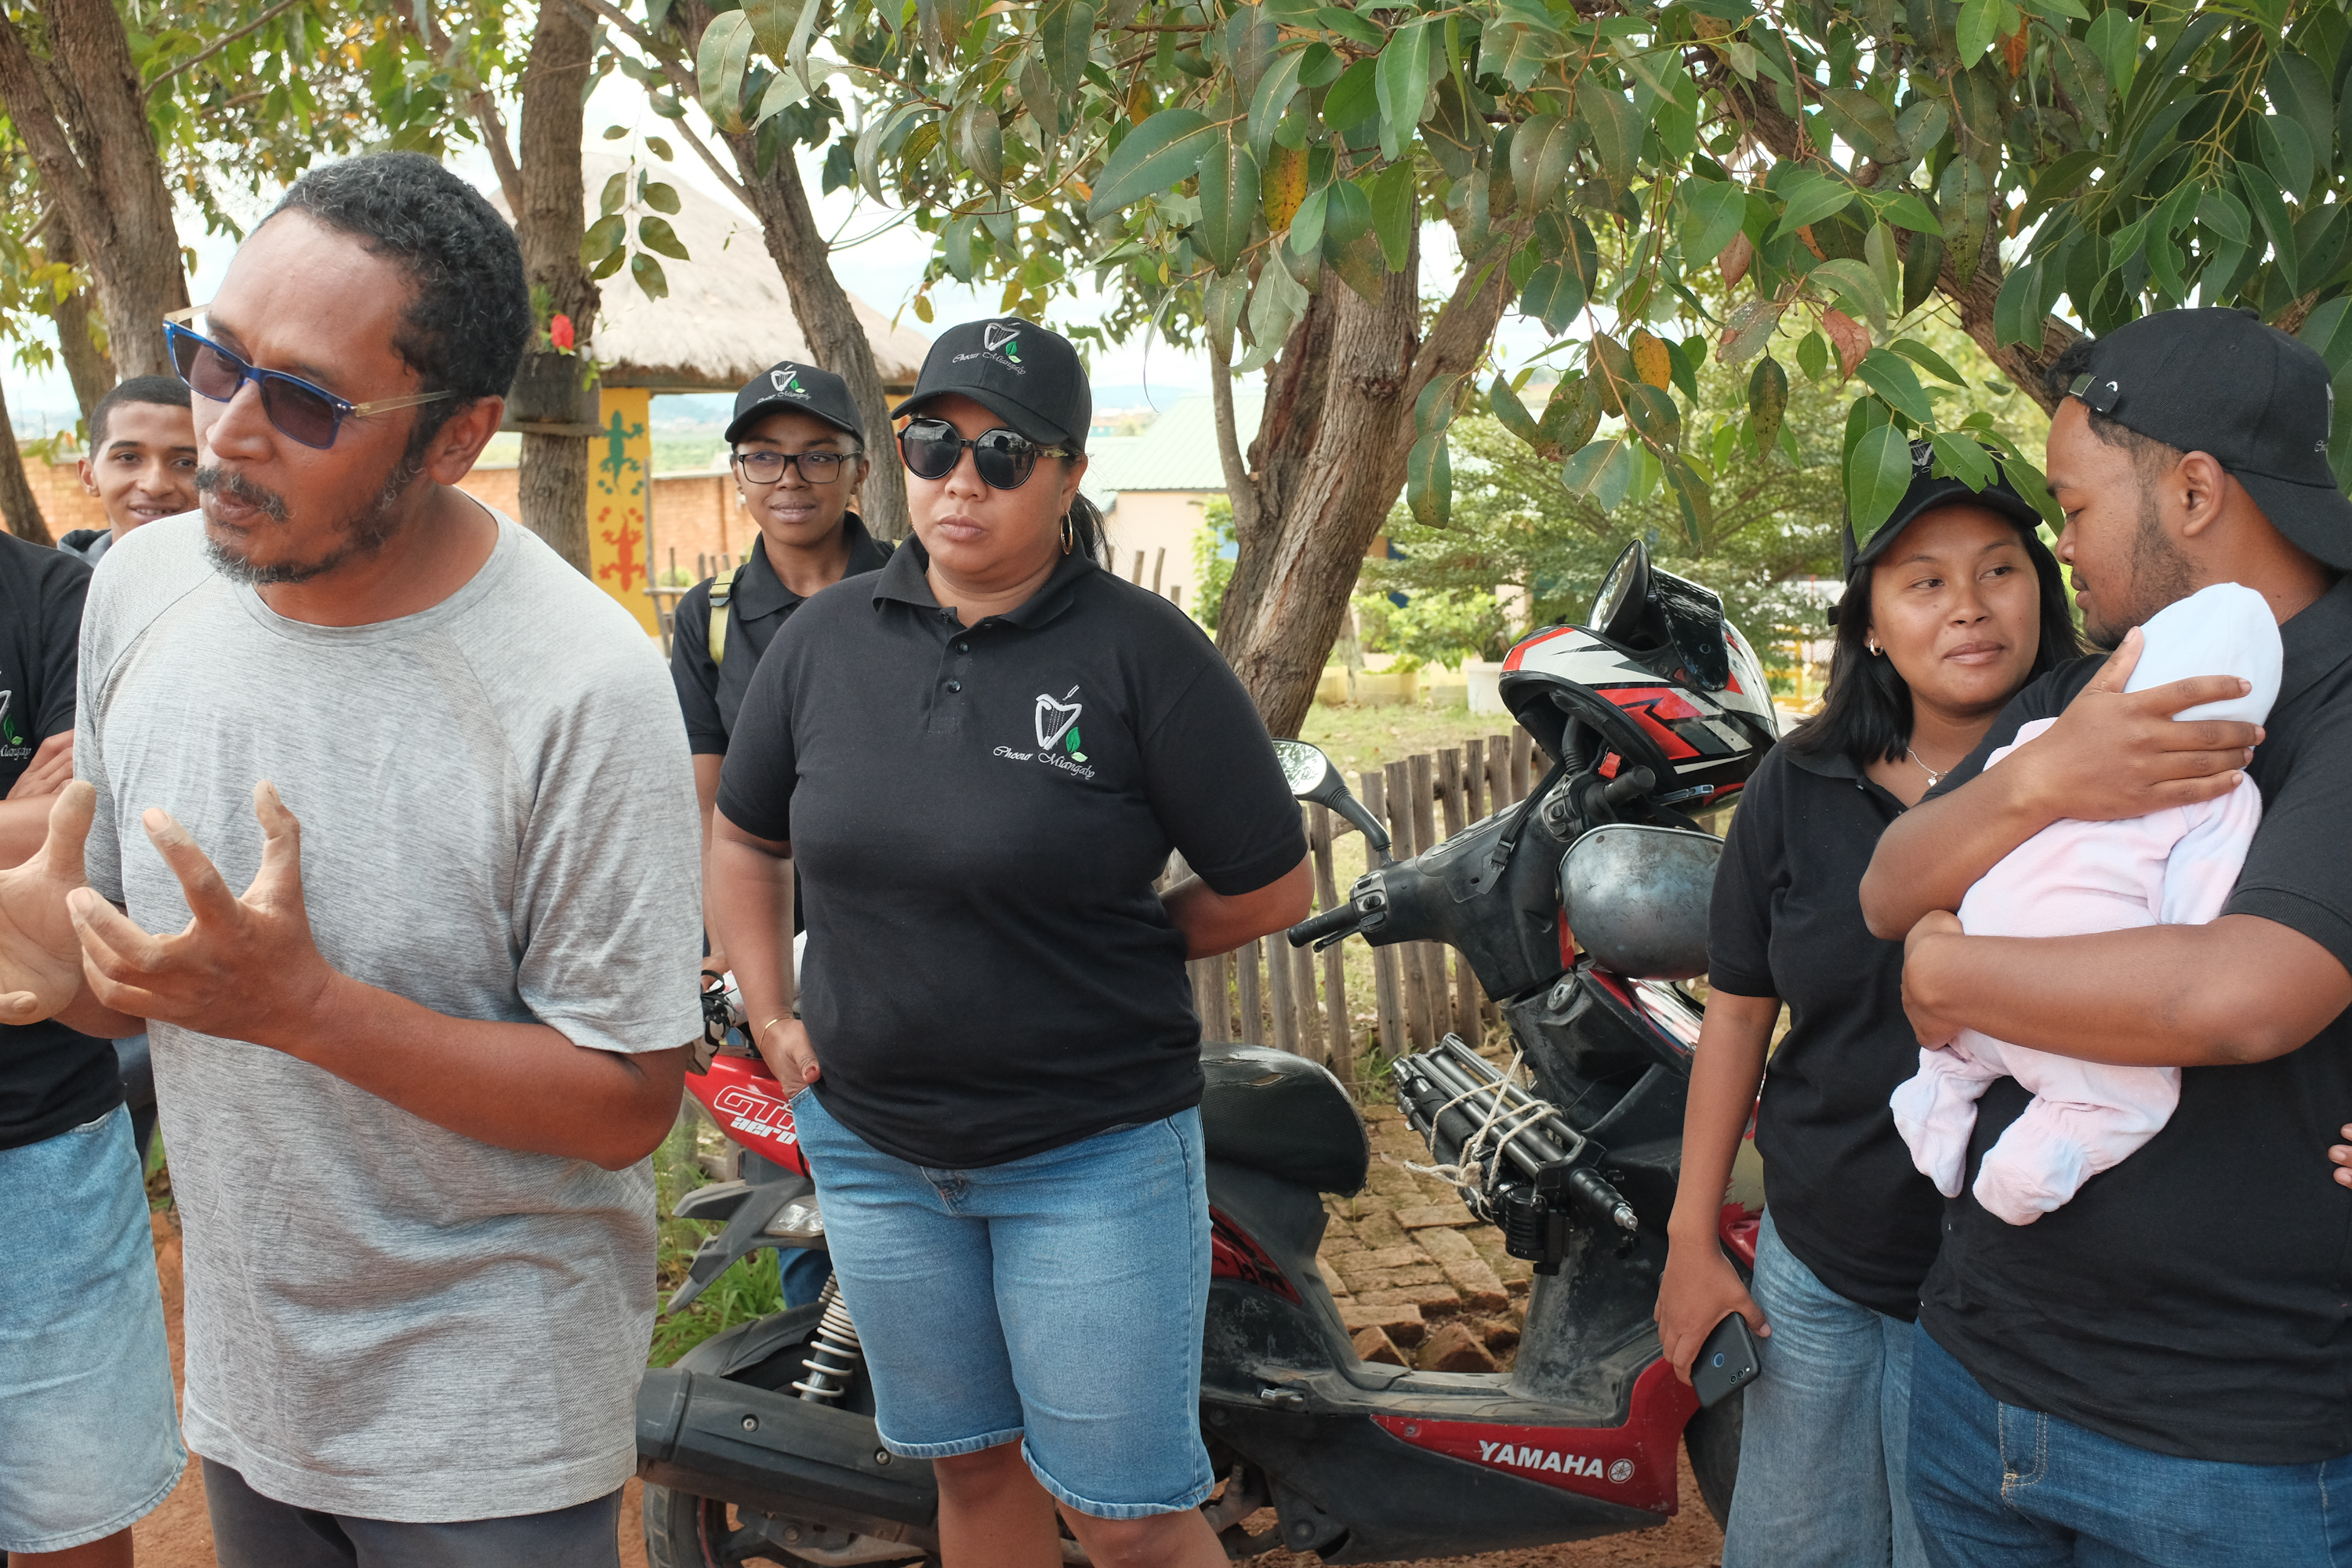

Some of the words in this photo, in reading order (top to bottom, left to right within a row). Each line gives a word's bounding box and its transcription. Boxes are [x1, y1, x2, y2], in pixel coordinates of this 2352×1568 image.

[1037, 752, 1095, 780] Miangaly
[730, 1116, 797, 1145] aero
[1479, 1439, 1604, 1479] YAMAHA
